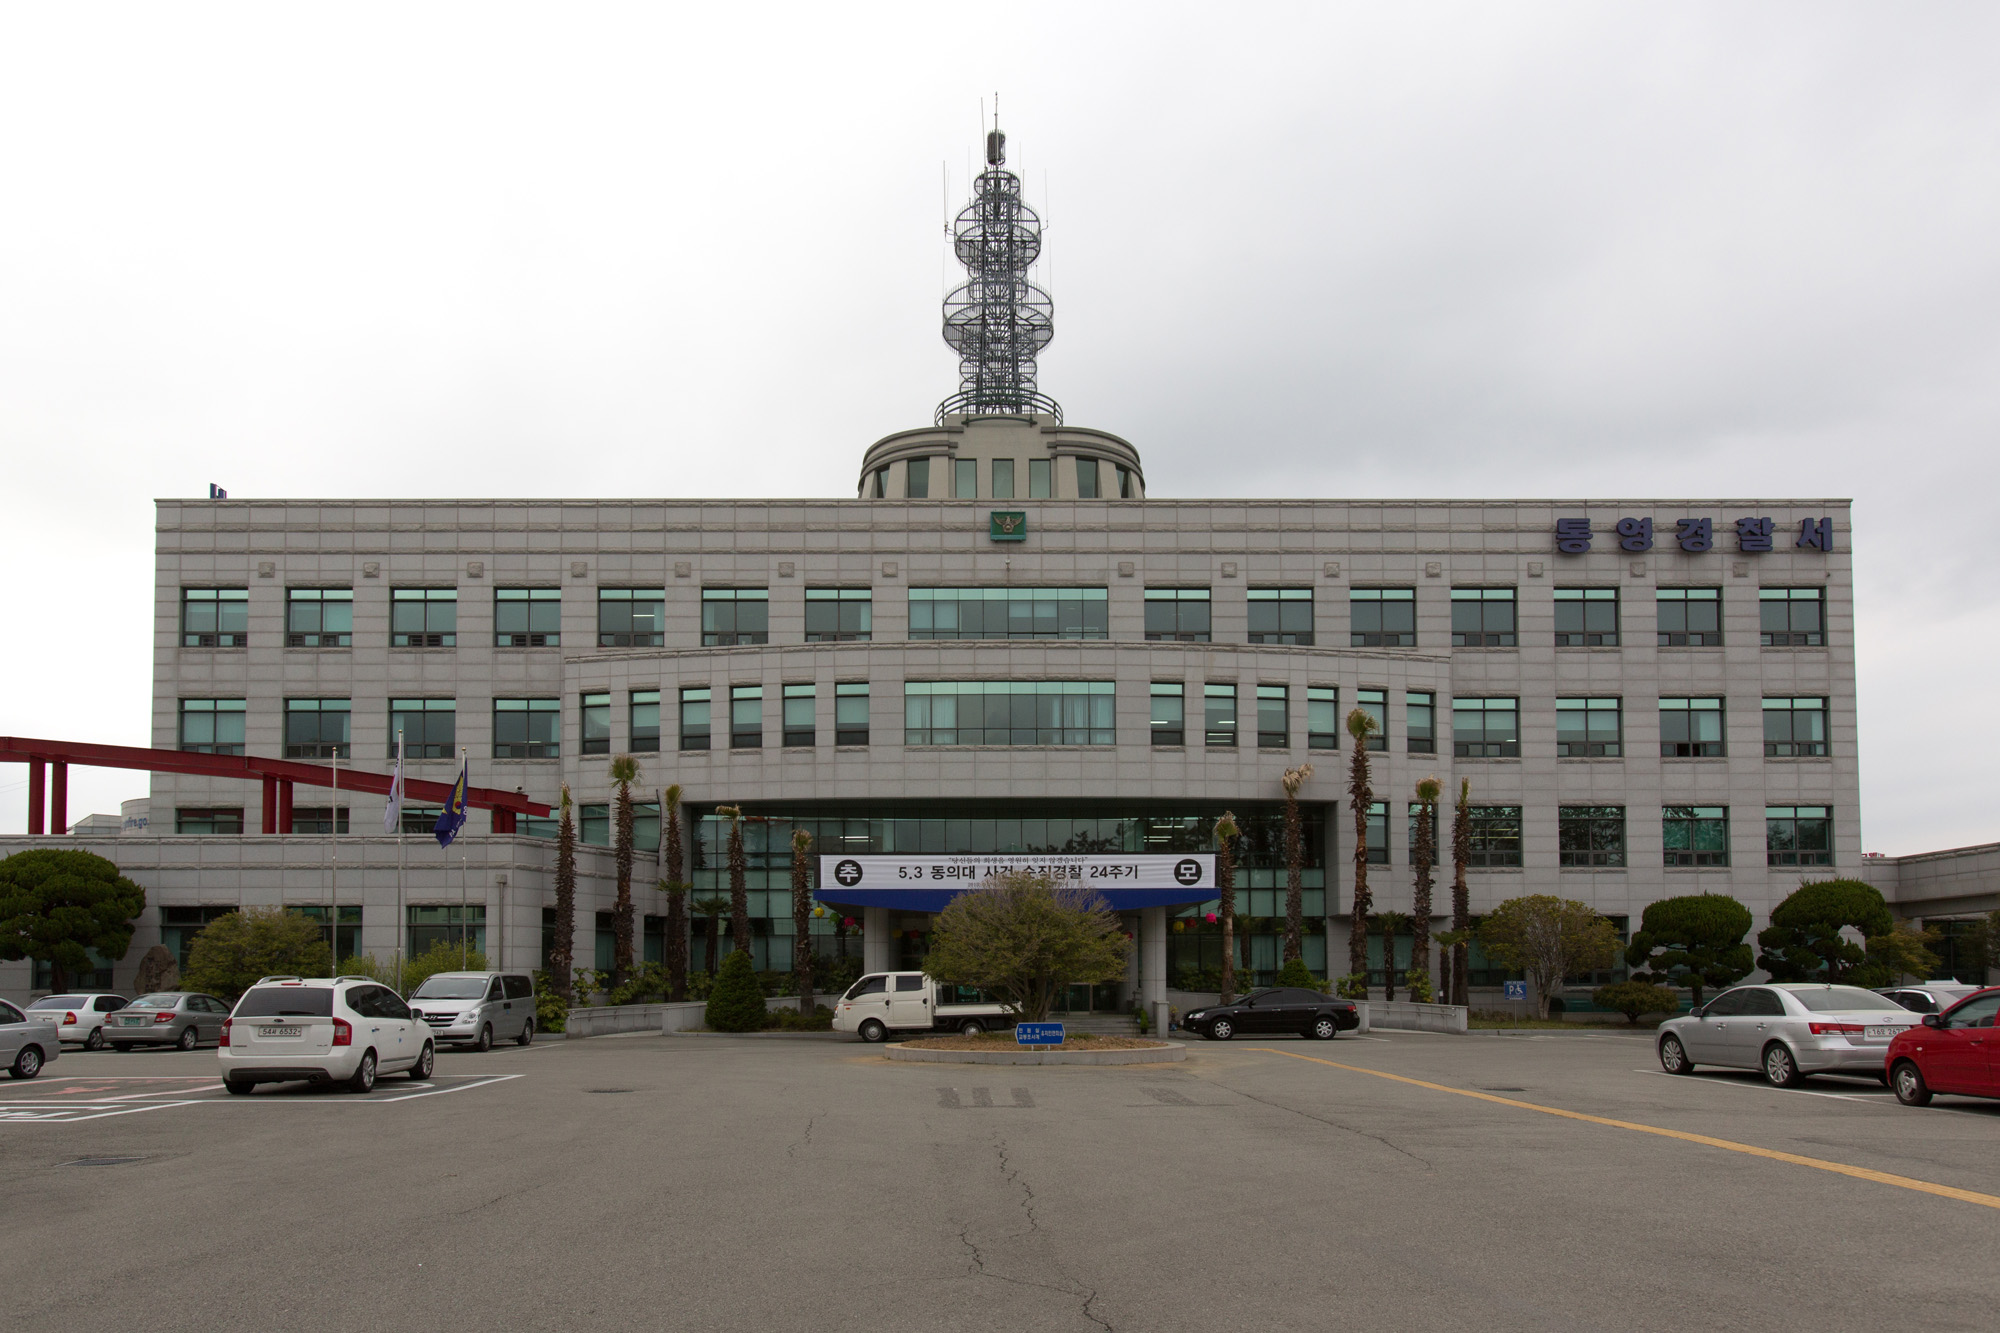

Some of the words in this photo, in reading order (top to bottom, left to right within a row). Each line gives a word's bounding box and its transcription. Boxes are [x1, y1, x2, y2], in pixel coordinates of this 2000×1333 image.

[1556, 517, 1833, 553] 통영경찰서
[839, 864, 859, 883] 추
[899, 866, 923, 879] 5.3
[930, 865, 976, 880] 동의대
[1090, 865, 1138, 879] 24주기
[1178, 864, 1198, 880] 모
